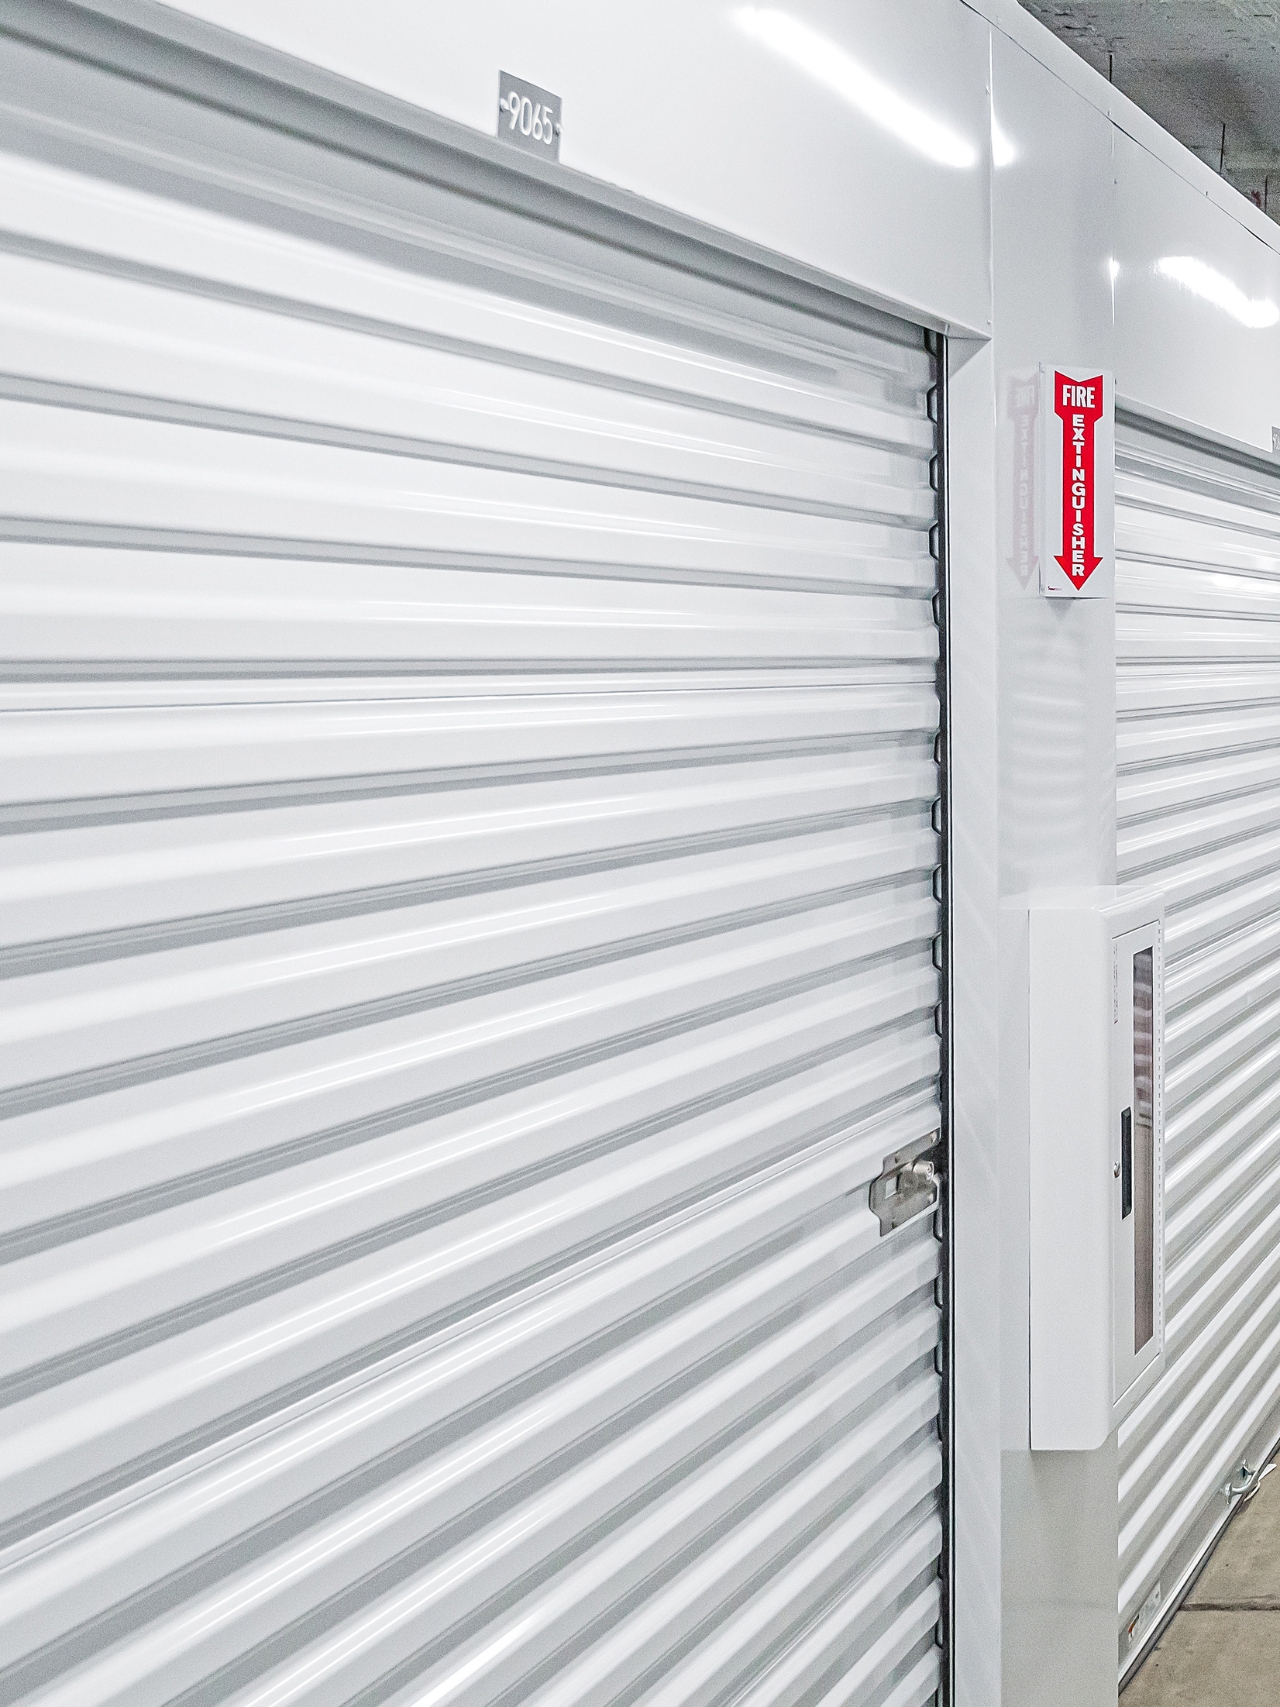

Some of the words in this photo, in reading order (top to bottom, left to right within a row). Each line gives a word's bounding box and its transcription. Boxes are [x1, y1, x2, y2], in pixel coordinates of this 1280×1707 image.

[507, 91, 553, 145] 9065
[1062, 384, 1095, 409] FIRE
[1071, 413, 1086, 577] EXTINGUISHER
